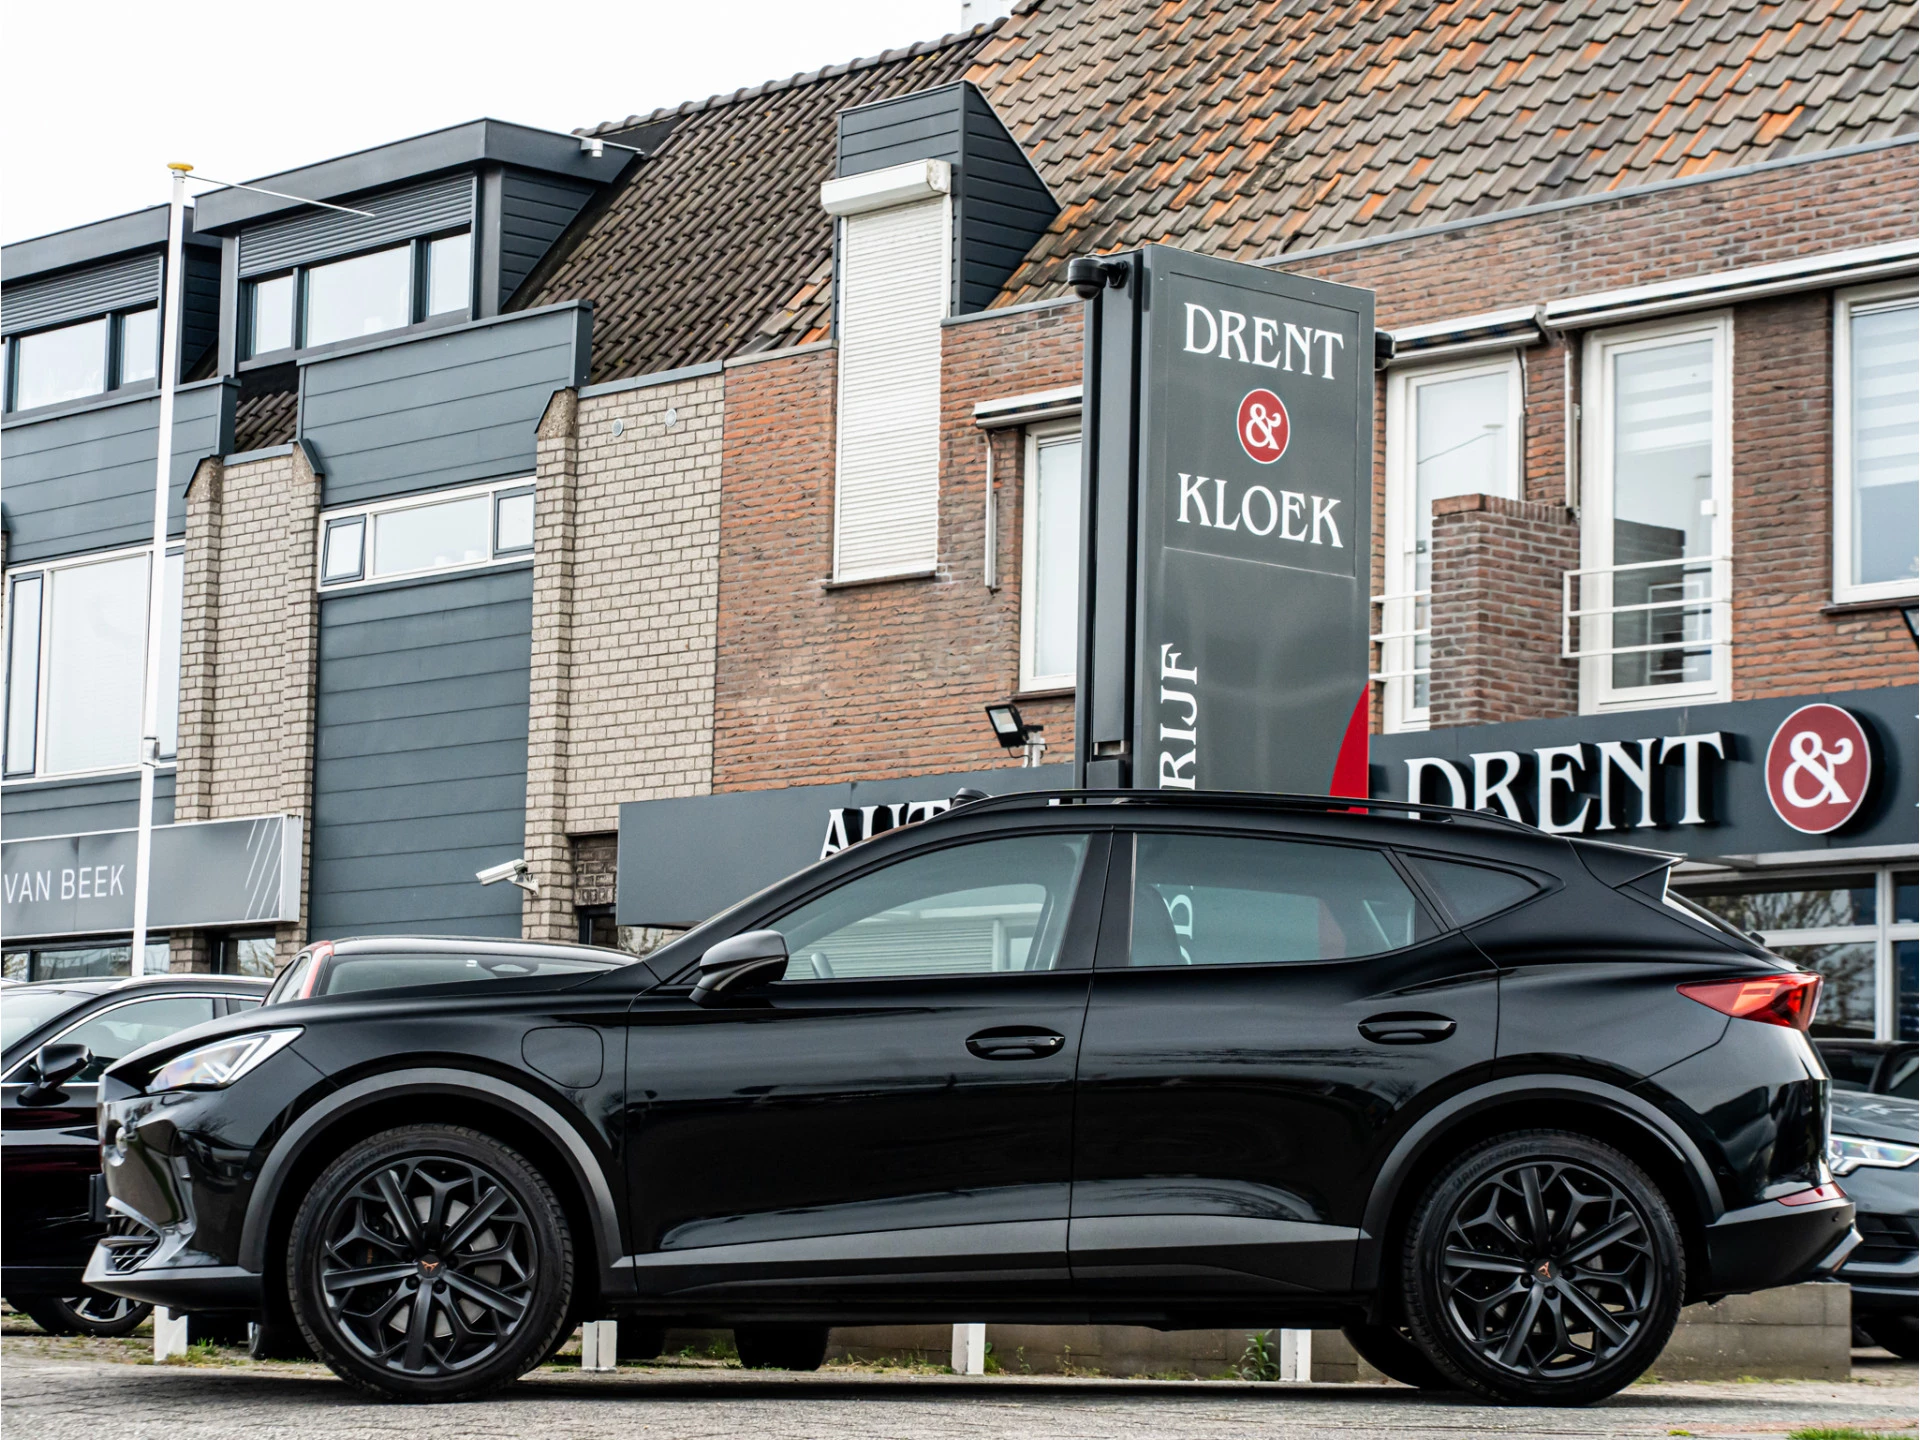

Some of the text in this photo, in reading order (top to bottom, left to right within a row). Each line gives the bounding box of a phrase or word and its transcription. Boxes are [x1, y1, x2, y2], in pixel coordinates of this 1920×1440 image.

[1183, 302, 1344, 380] DRENT
[1245, 403, 1282, 450] &
[1177, 472, 1344, 548] KLOEK
[1404, 731, 1725, 834] DRENT
[1782, 730, 1854, 808] &
[4, 865, 125, 904] VAN BEEK
